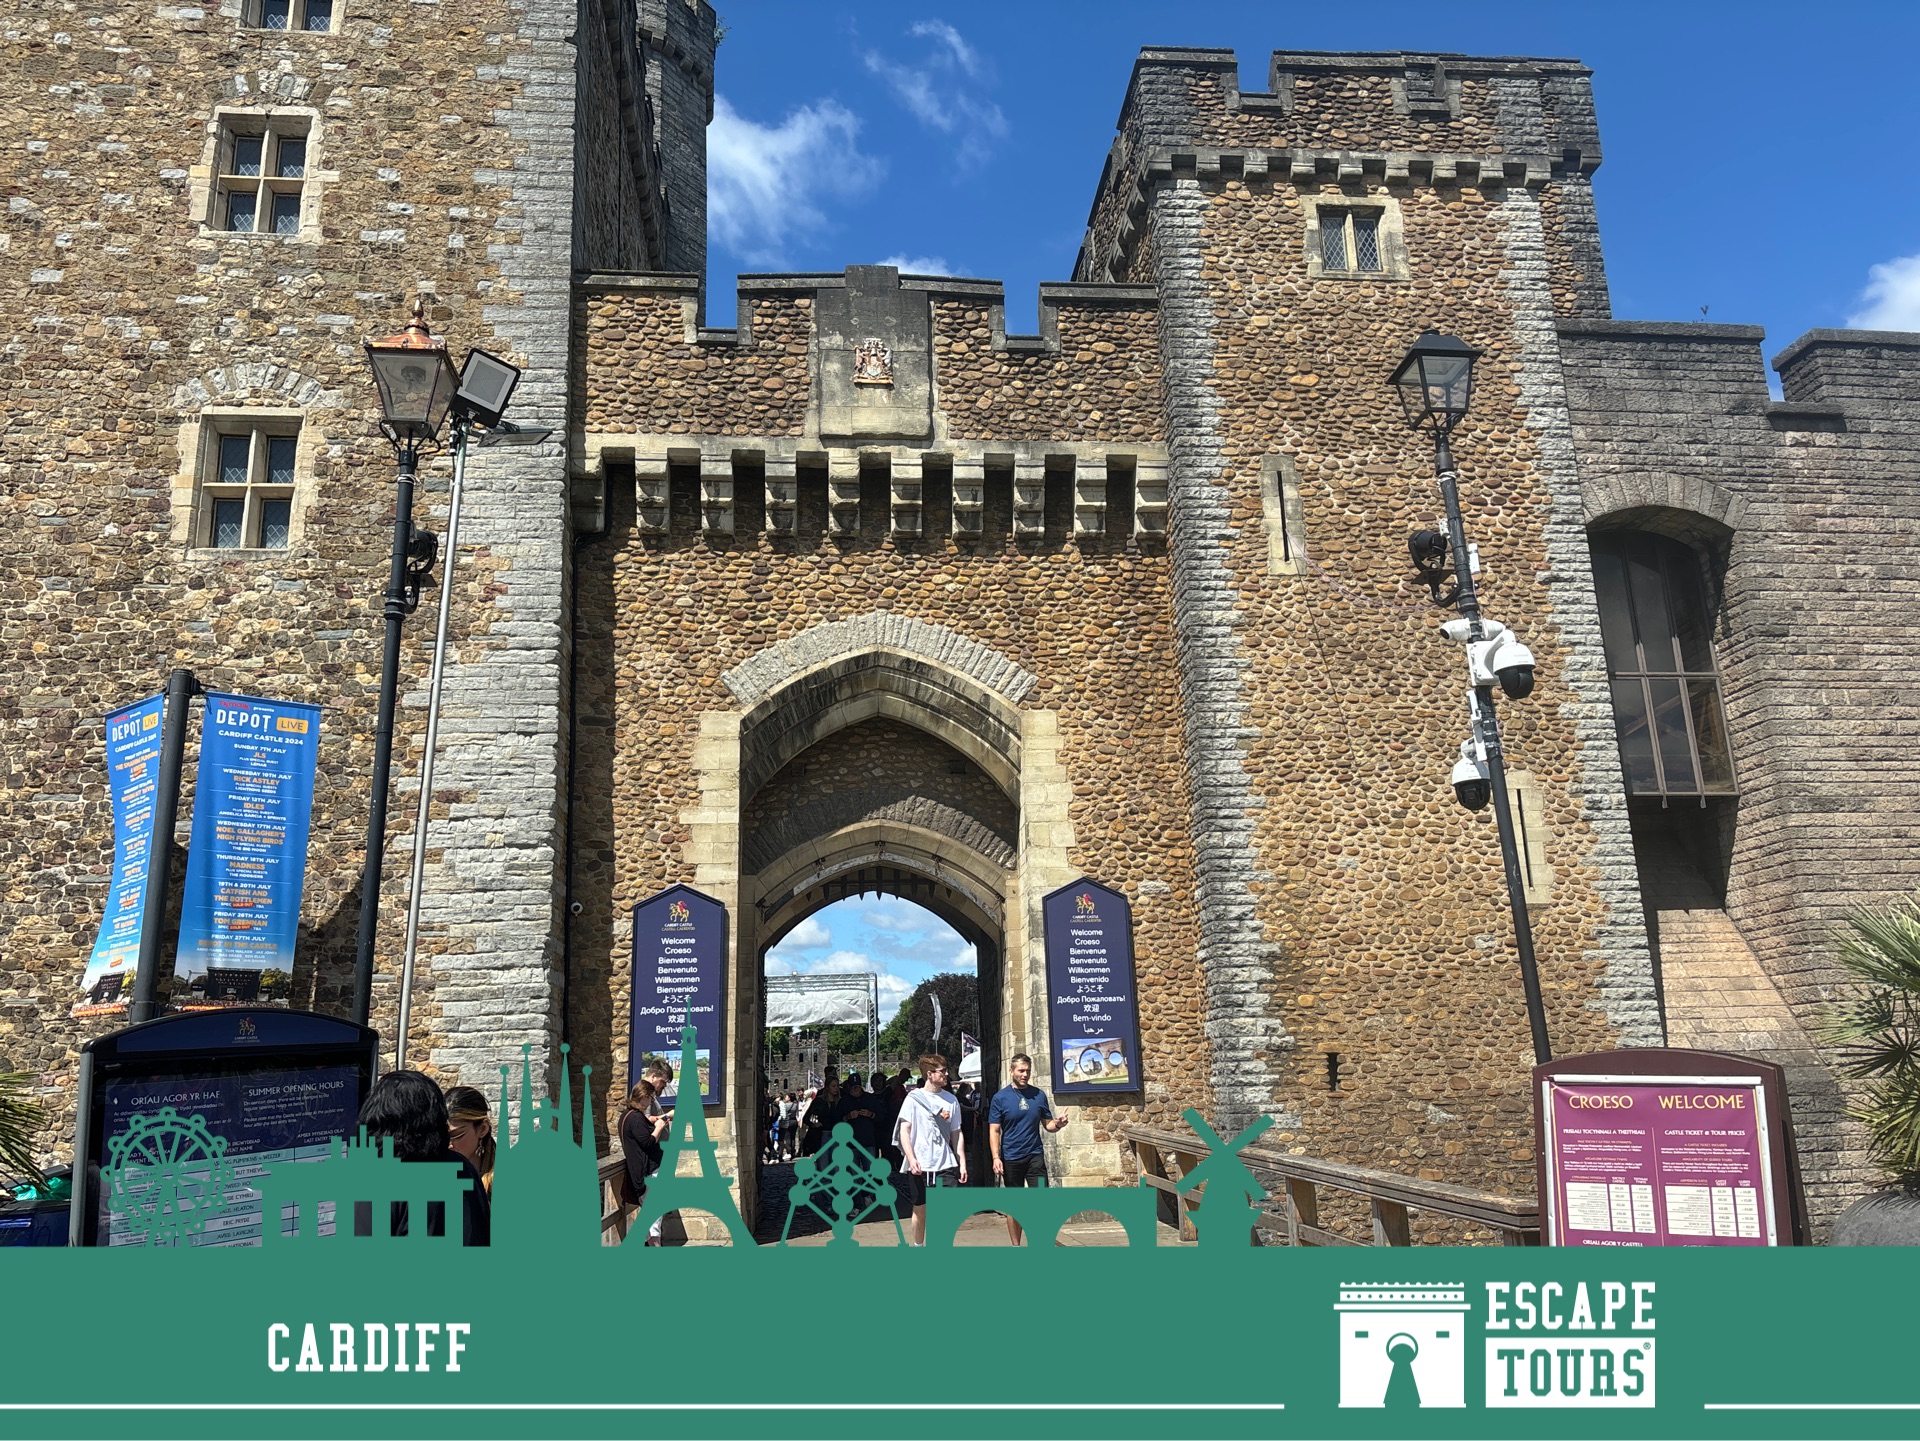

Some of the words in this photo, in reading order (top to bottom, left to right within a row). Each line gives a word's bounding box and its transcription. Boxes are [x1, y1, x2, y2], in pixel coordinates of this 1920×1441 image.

[216, 709, 271, 732] DEPOT
[281, 720, 304, 730] LIVE
[112, 719, 140, 742] DEPOT
[144, 716, 157, 727] LIVE
[218, 730, 253, 739] CARDIFF
[254, 734, 283, 742] CASTLE
[115, 741, 133, 753] CARDIFF
[134, 737, 147, 746] CASTLE
[223, 768, 260, 776] WEDNESDAY
[1077, 985, 1104, 993] ようこそ
[1057, 996, 1080, 1005] Добро
[1081, 995, 1126, 1004] Пожаловать!
[640, 1006, 665, 1016] Добро
[667, 1005, 714, 1014] Пожаовать!
[1084, 1004, 1100, 1012] 欢迎
[1073, 1014, 1111, 1022] Bem-vindo
[249, 1087, 280, 1097] SUMMER
[283, 1084, 316, 1093] OPENING
[319, 1081, 344, 1090] HOURS
[131, 1096, 160, 1106] ORIAU
[162, 1094, 188, 1103] AGOR
[203, 1091, 220, 1099] HAF
[1569, 1095, 1633, 1109] CROESO
[1657, 1094, 1745, 1109] WELCOME
